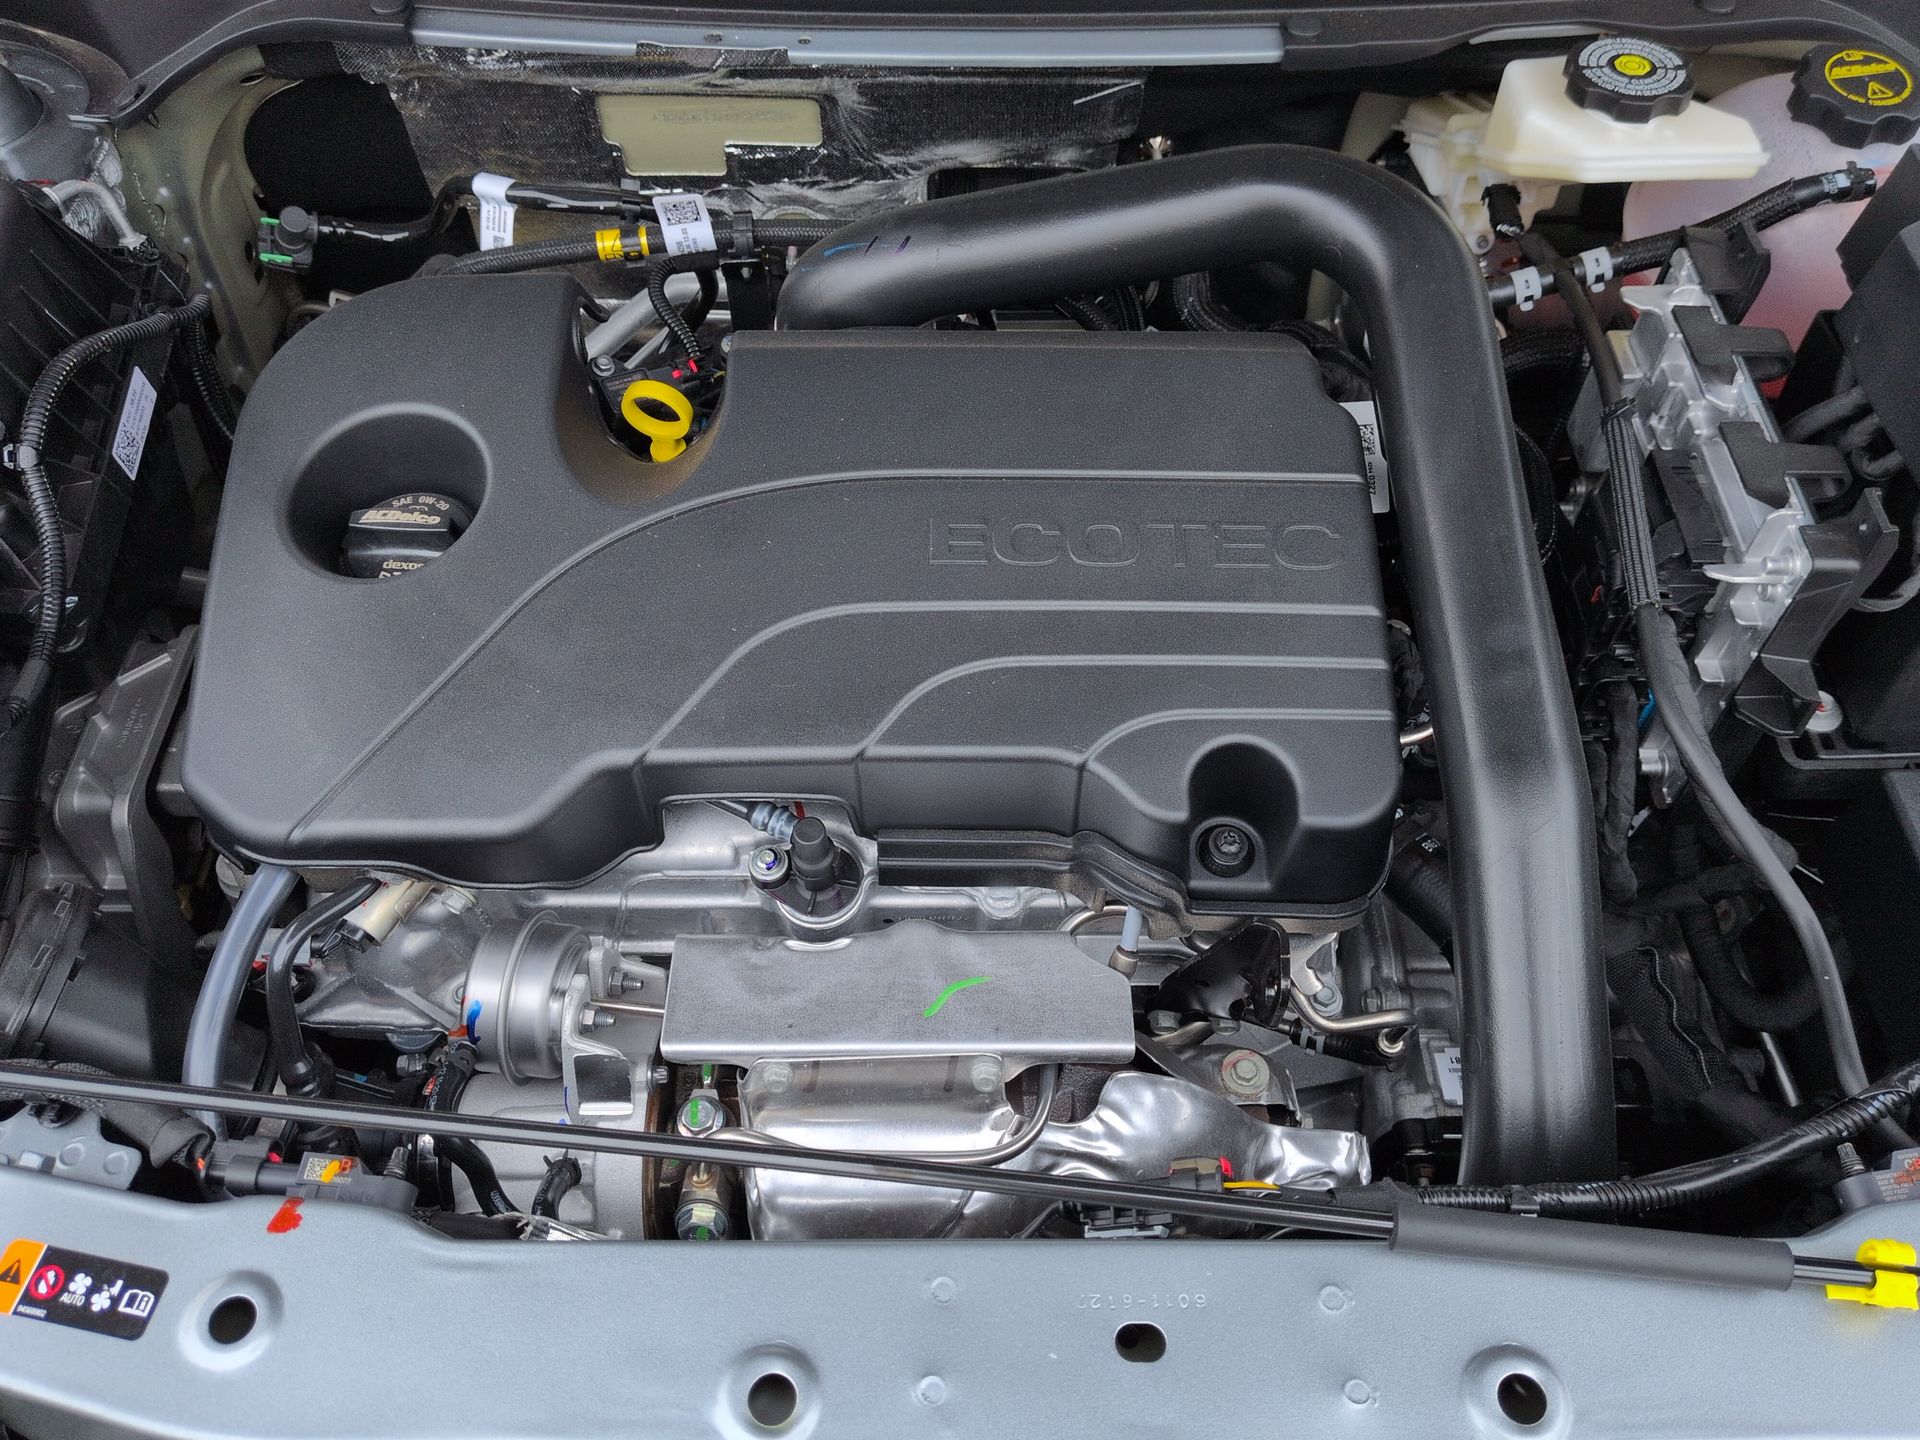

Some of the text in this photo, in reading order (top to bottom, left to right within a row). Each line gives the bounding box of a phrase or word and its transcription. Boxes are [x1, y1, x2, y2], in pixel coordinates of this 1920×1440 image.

[392, 495, 450, 511] SAE 0W-20
[359, 510, 441, 525] ACDelco
[929, 519, 1342, 570] ECOTEC
[59, 1292, 86, 1307] AUTO
